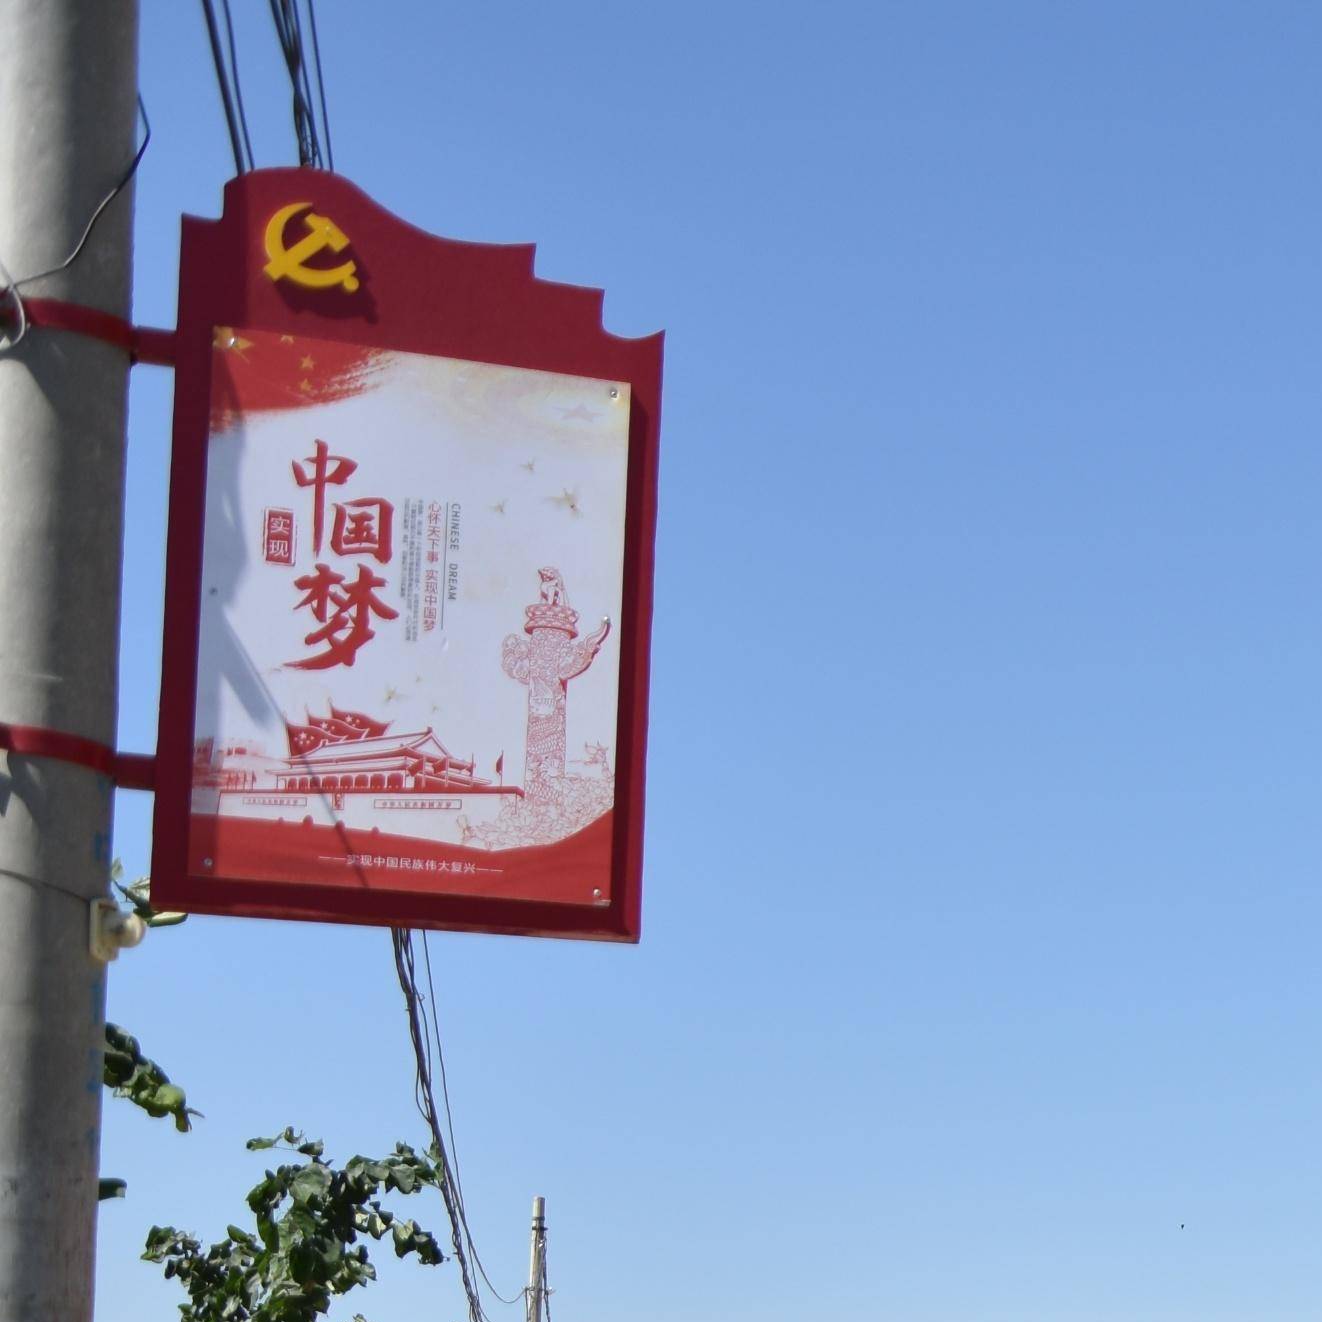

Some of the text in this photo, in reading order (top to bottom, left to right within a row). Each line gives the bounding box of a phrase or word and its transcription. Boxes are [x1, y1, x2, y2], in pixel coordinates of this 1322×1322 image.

[268, 514, 292, 559] 实现
[282, 438, 400, 671] 中国梦
[447, 503, 462, 601] CHINESE DREAM
